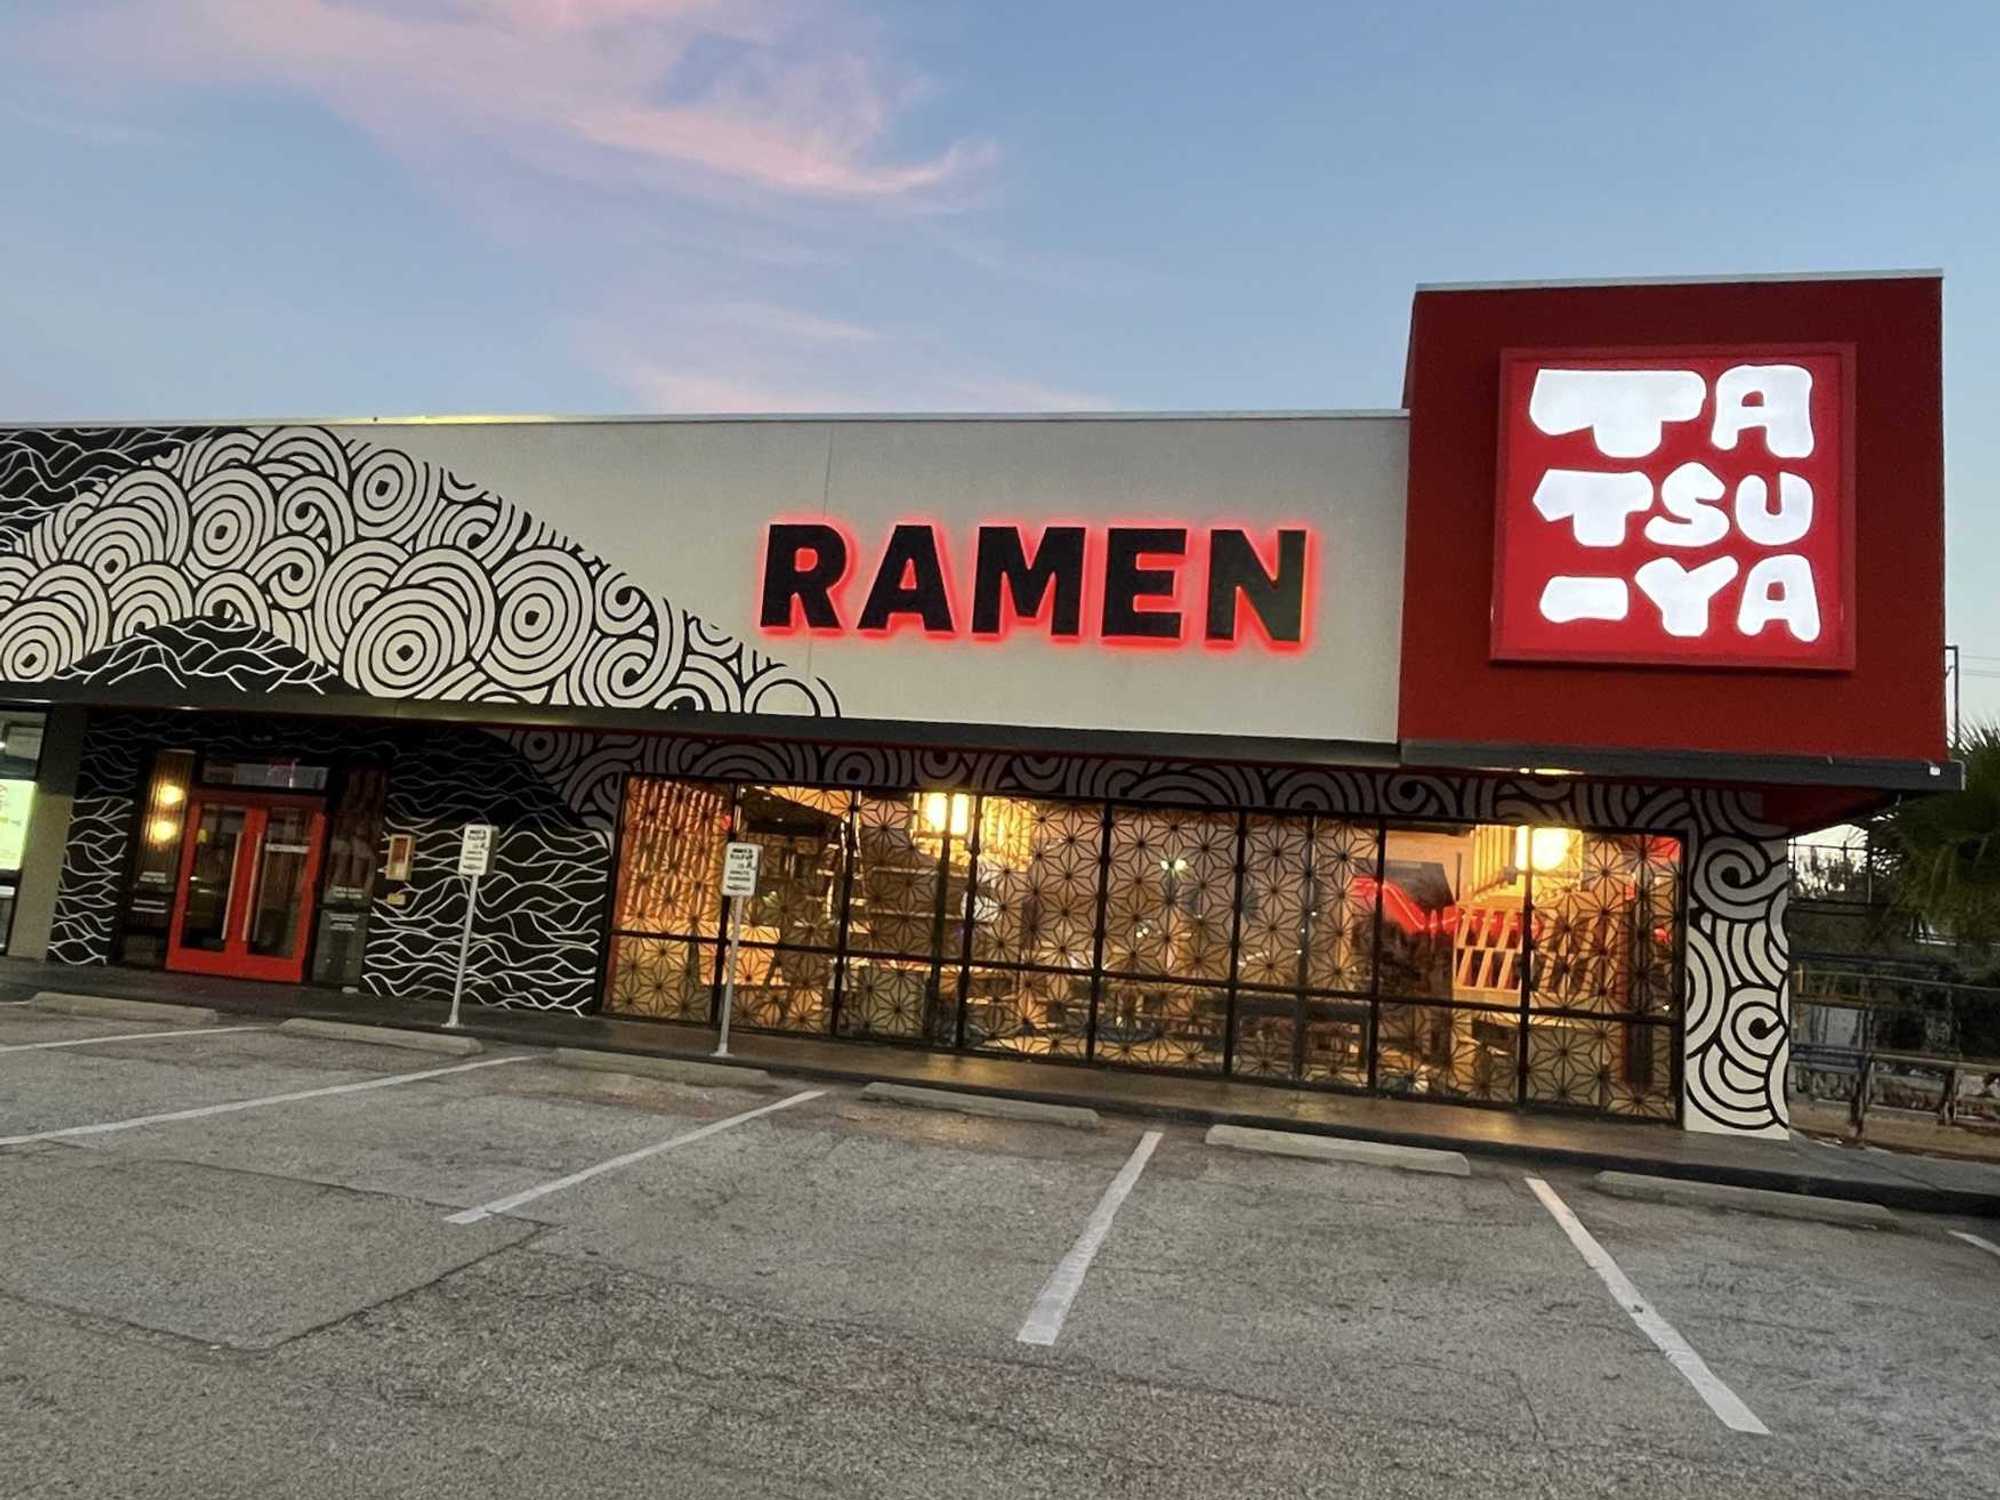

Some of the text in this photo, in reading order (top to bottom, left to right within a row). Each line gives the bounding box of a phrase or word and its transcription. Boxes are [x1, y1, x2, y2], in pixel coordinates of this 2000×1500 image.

[1528, 364, 1815, 459] TA
[1532, 461, 1814, 548] TSU
[760, 523, 1306, 642] RAMEN
